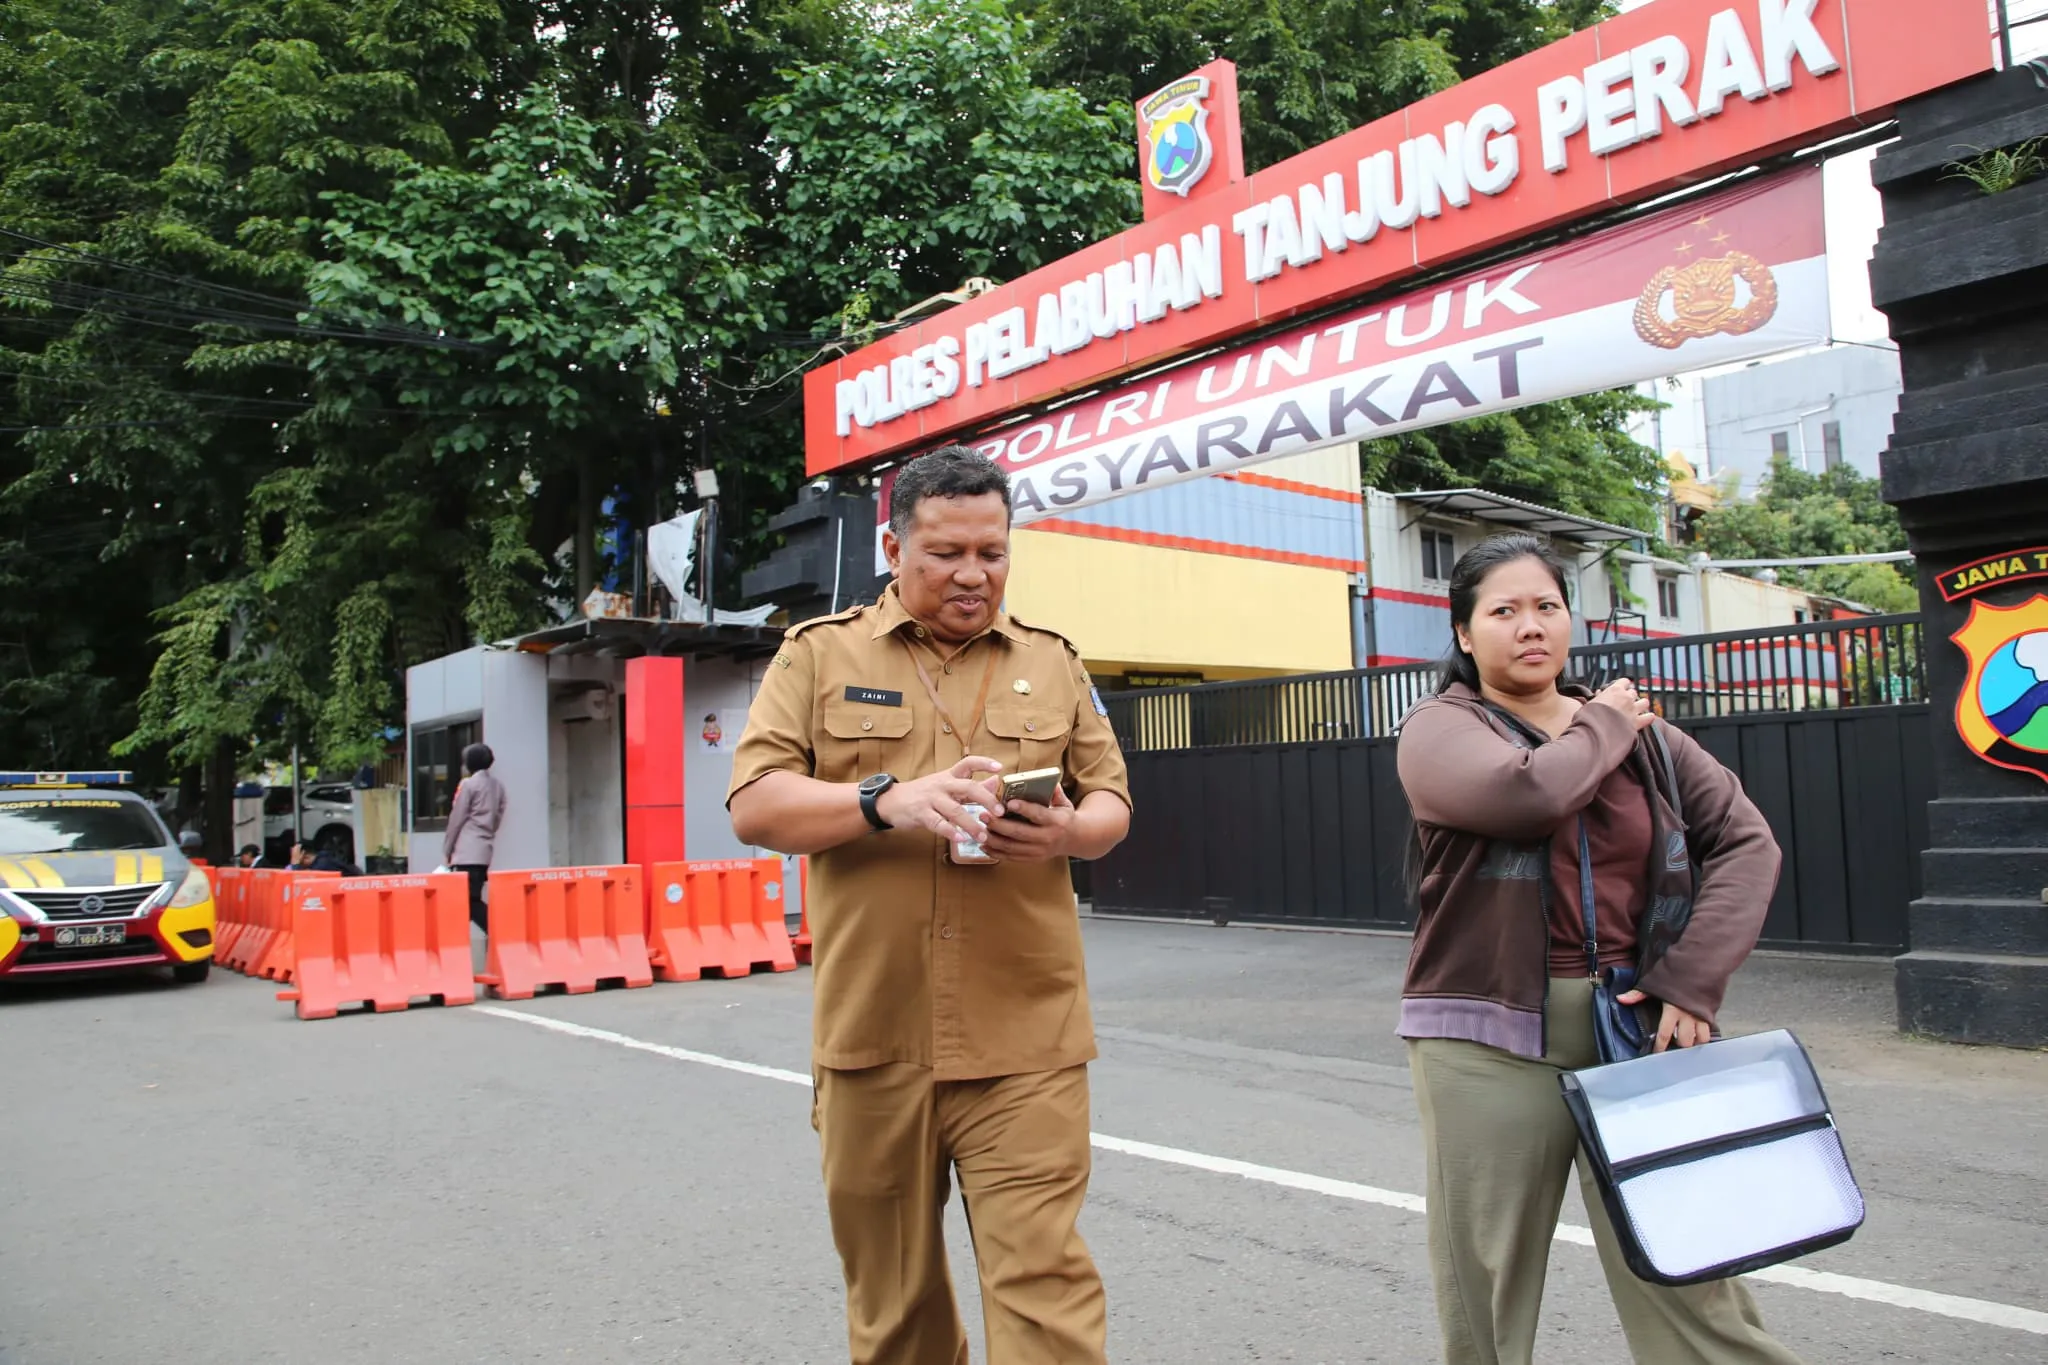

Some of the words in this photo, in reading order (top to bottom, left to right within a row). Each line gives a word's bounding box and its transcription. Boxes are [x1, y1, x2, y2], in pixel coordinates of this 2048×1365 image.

[1146, 93, 1169, 115] JAWA
[1171, 81, 1199, 95] TIMUR
[836, 335, 961, 436] POLRES
[965, 224, 1222, 388] PELABUHAN
[1232, 103, 1519, 284] TANJUNG
[1537, 0, 1840, 174] PERAK
[976, 381, 1171, 463] POLRI
[1194, 262, 1542, 403] UNTUK
[1011, 336, 1544, 518] ASYARAKAT
[1953, 557, 2028, 590] JAWA
